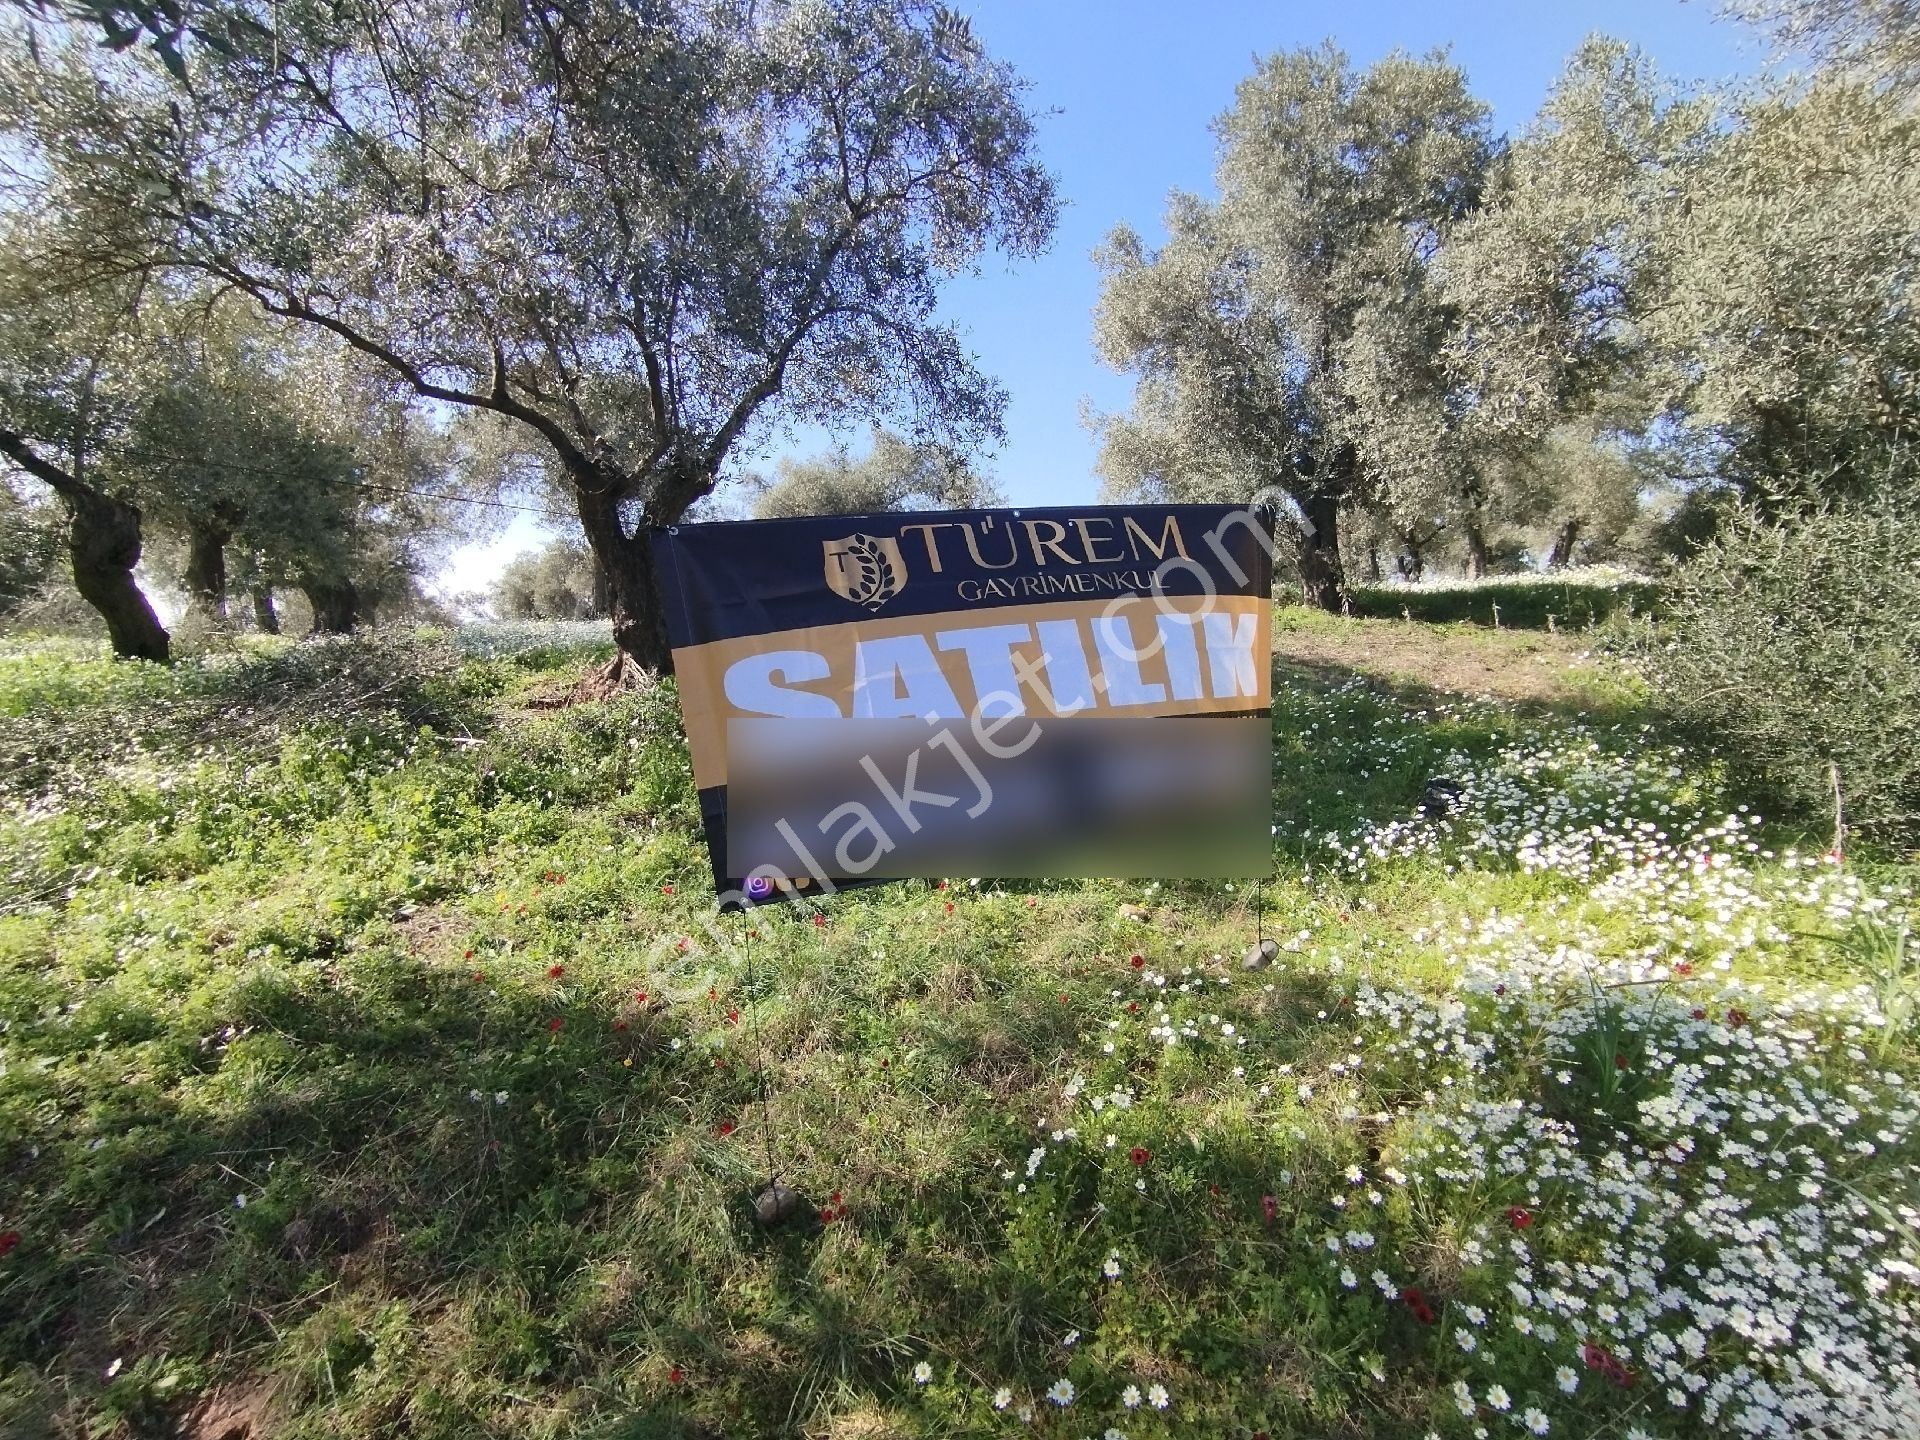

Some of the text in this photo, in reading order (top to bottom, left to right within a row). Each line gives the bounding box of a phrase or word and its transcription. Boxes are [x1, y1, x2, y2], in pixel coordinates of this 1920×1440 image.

[828, 551, 850, 573] T
[900, 515, 1195, 573] TÜREM
[956, 569, 1172, 601] GAYRİMENKUL
[723, 612, 1260, 719] SATILIK
